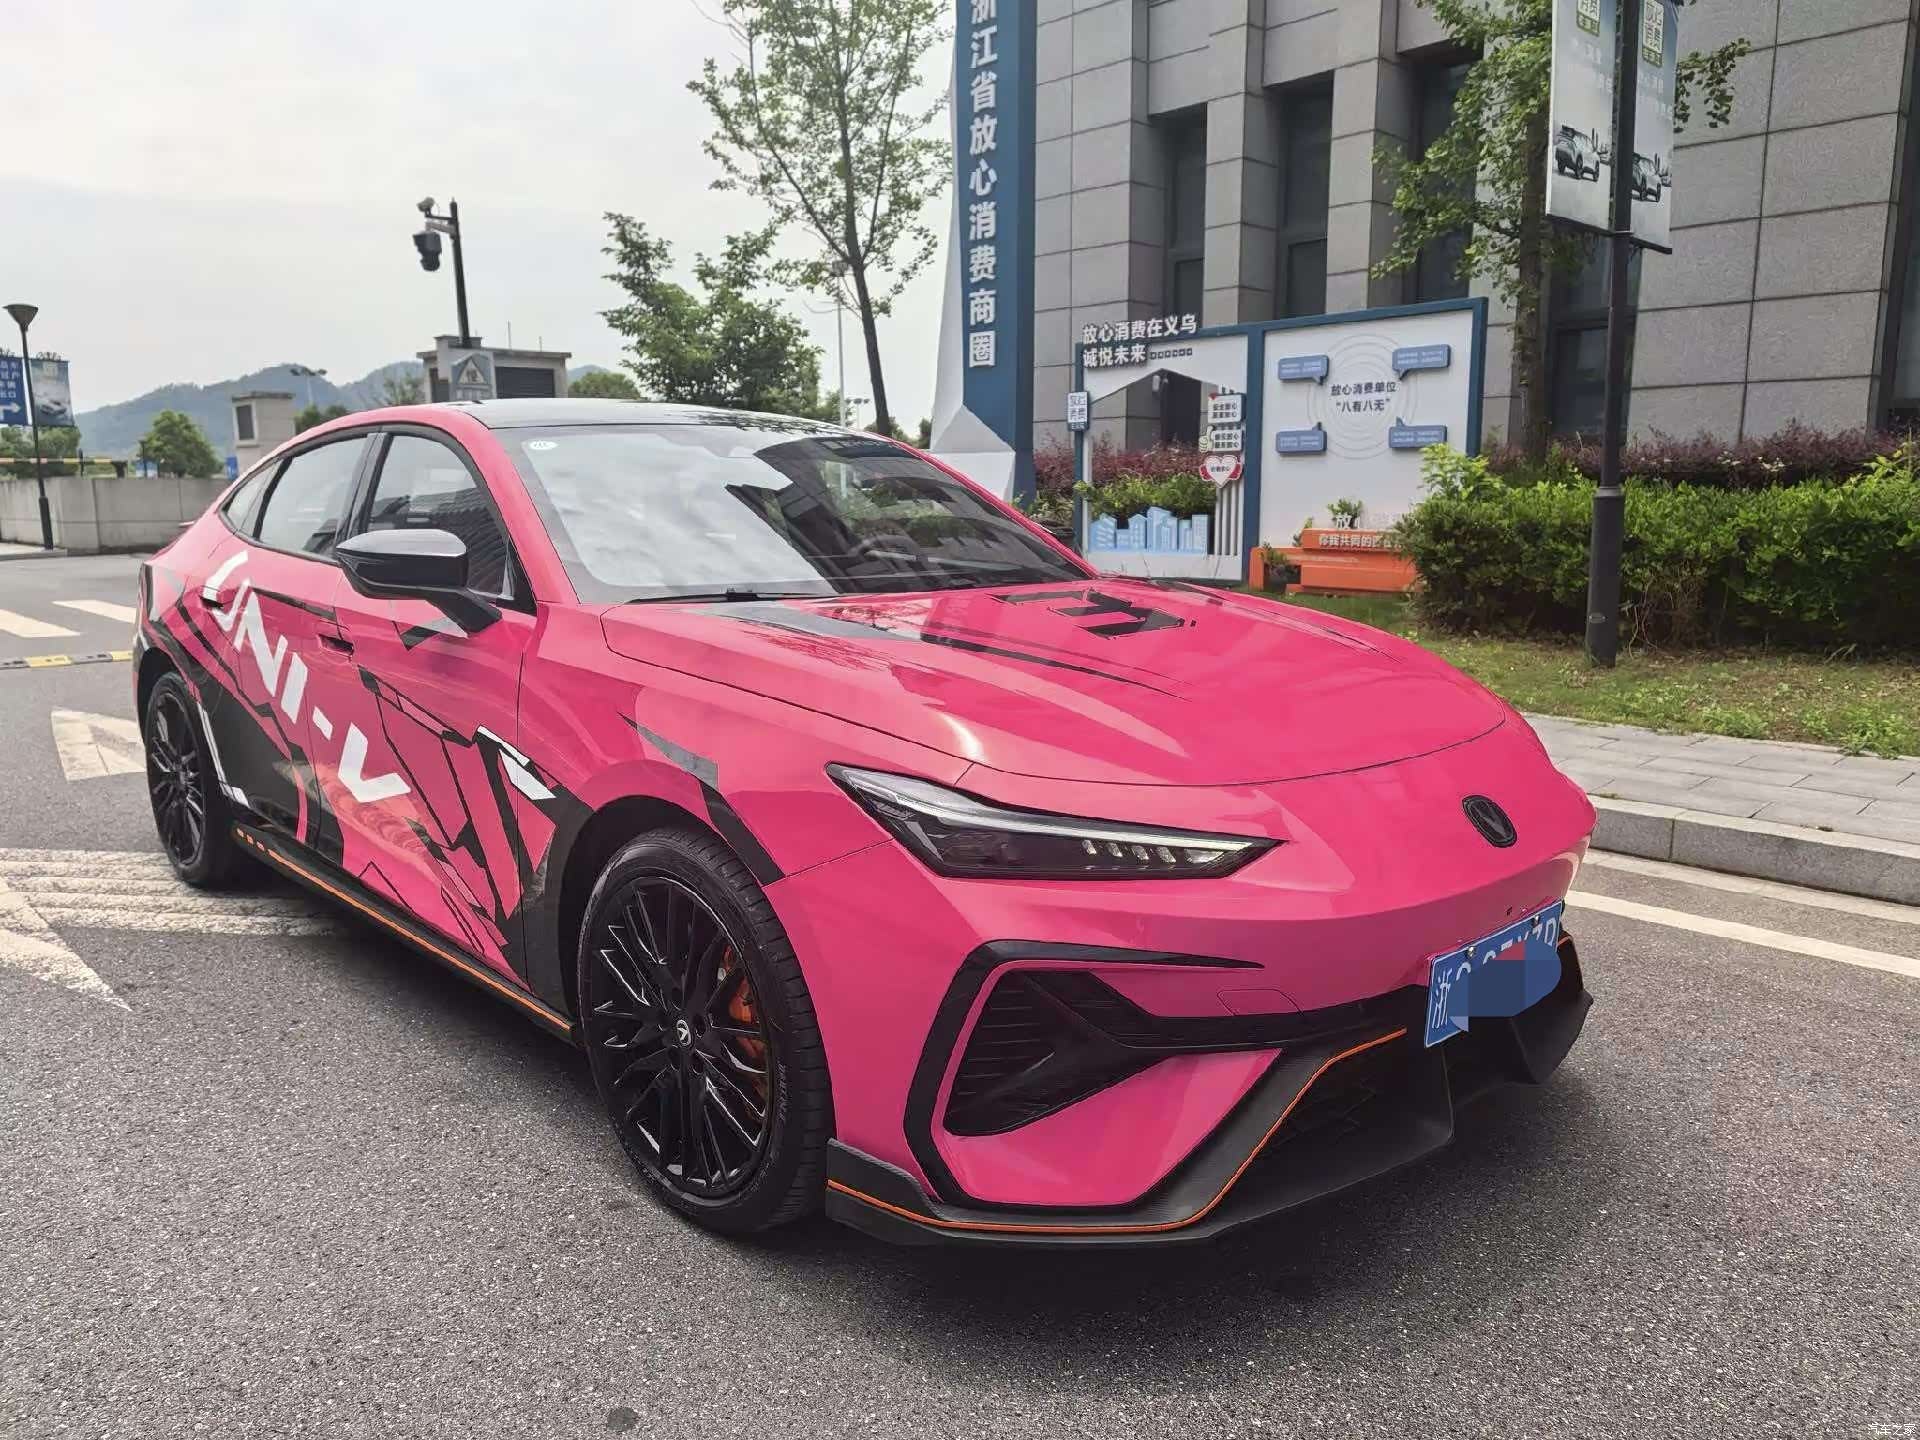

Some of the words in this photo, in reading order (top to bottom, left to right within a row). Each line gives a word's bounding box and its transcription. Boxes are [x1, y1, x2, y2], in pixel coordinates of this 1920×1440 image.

[1082, 314, 1197, 344] 放心消费在义乌
[1331, 381, 1397, 397] 放心消费单位
[202, 550, 412, 803] UNI-V
